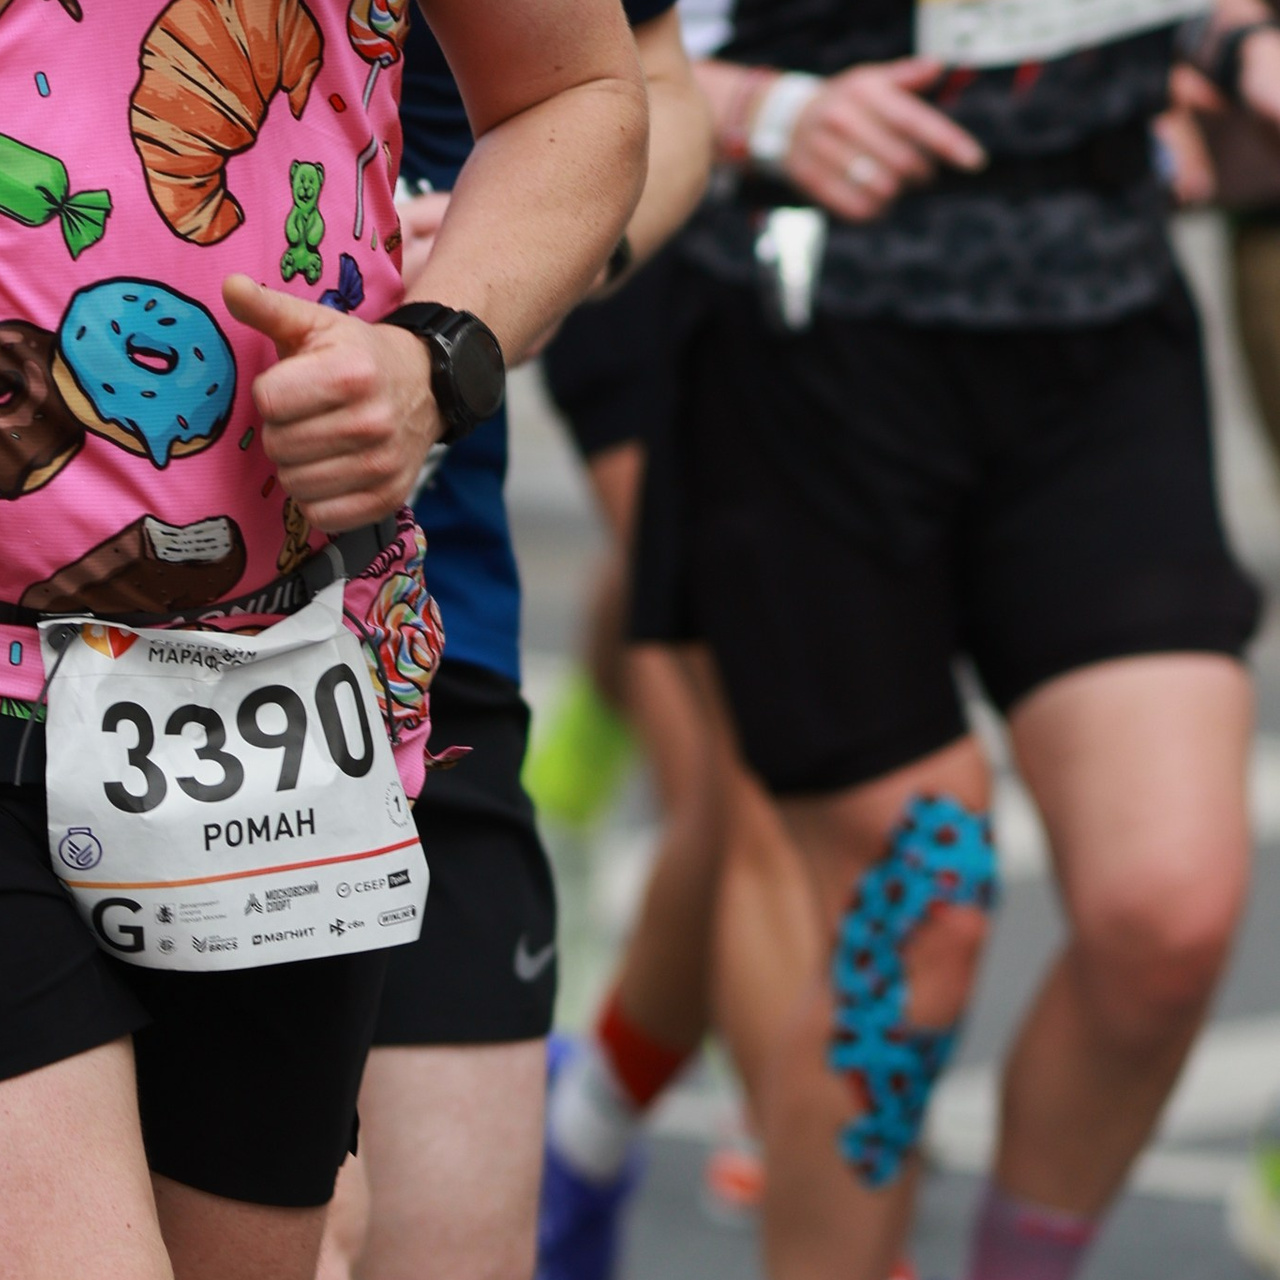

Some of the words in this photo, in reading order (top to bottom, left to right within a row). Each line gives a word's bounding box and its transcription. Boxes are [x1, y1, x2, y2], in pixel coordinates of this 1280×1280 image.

[102, 662, 374, 814] 3390
[204, 808, 316, 851] РОМАН
[354, 878, 386, 893] СБЕР
[91, 896, 145, 954] G
